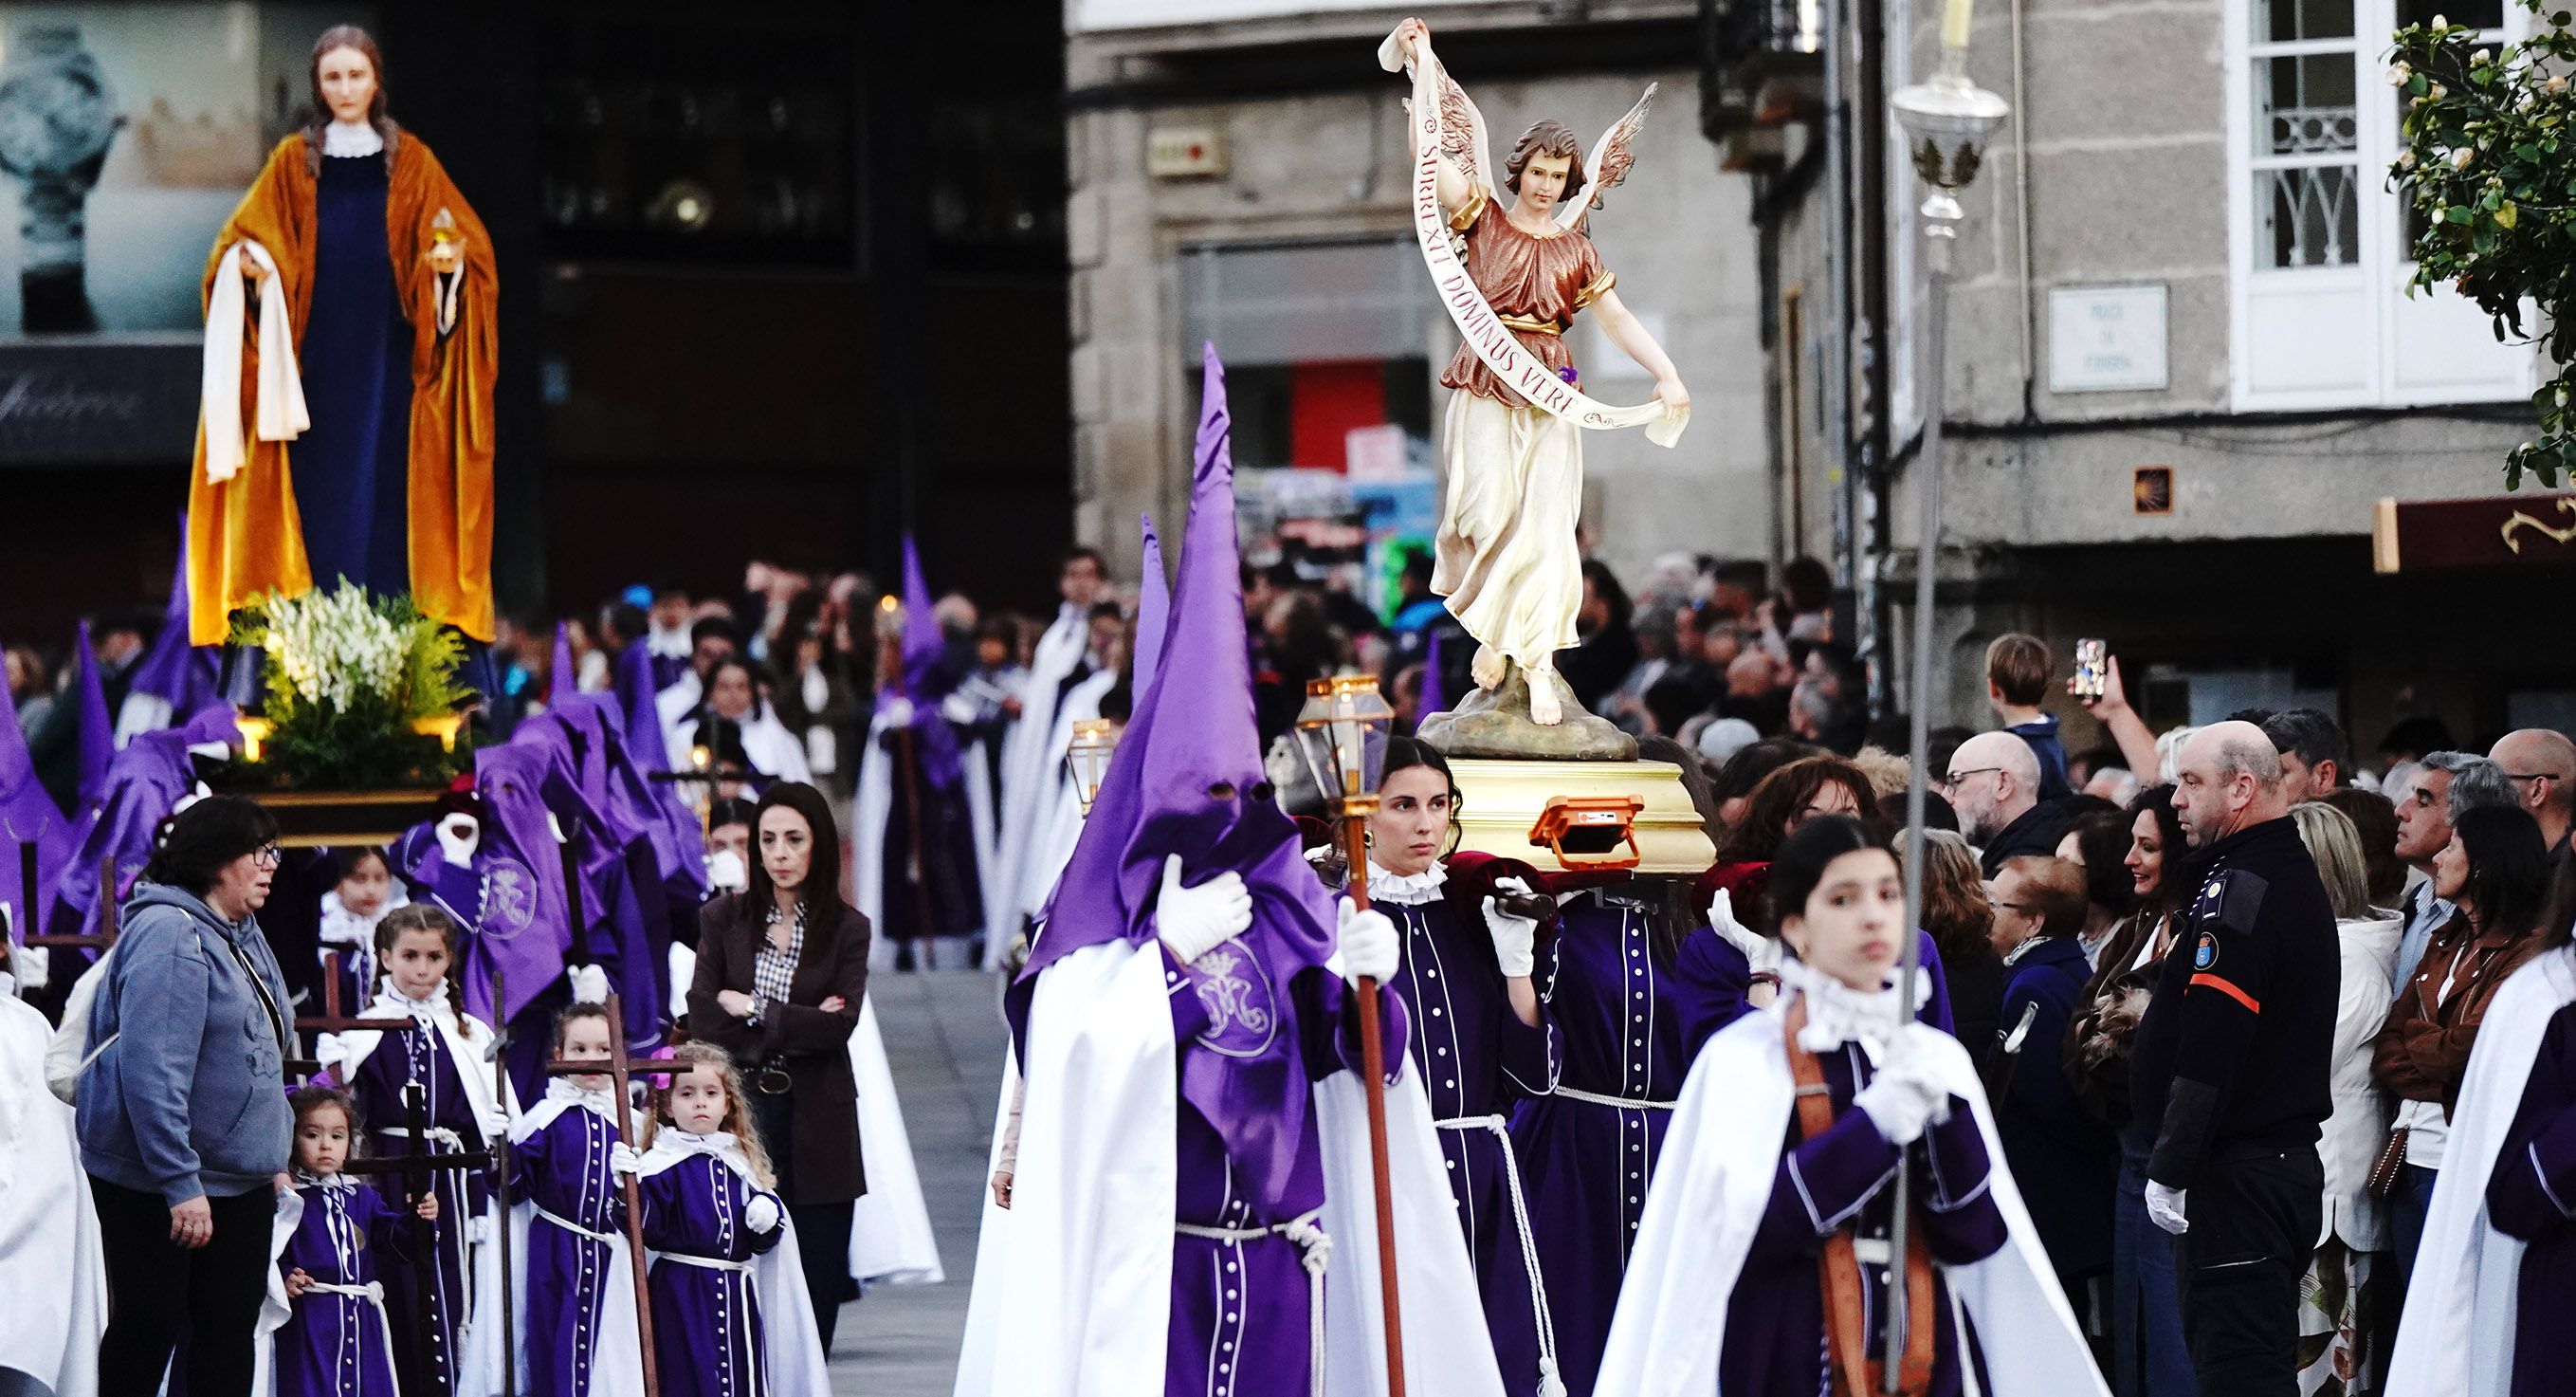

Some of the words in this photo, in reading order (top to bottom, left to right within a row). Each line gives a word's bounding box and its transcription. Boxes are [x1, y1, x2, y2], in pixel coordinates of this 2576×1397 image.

[1418, 145, 1452, 267] SURREXIT
[1442, 275, 1520, 372] DOMINUS
[1520, 366, 1580, 416] VERE
